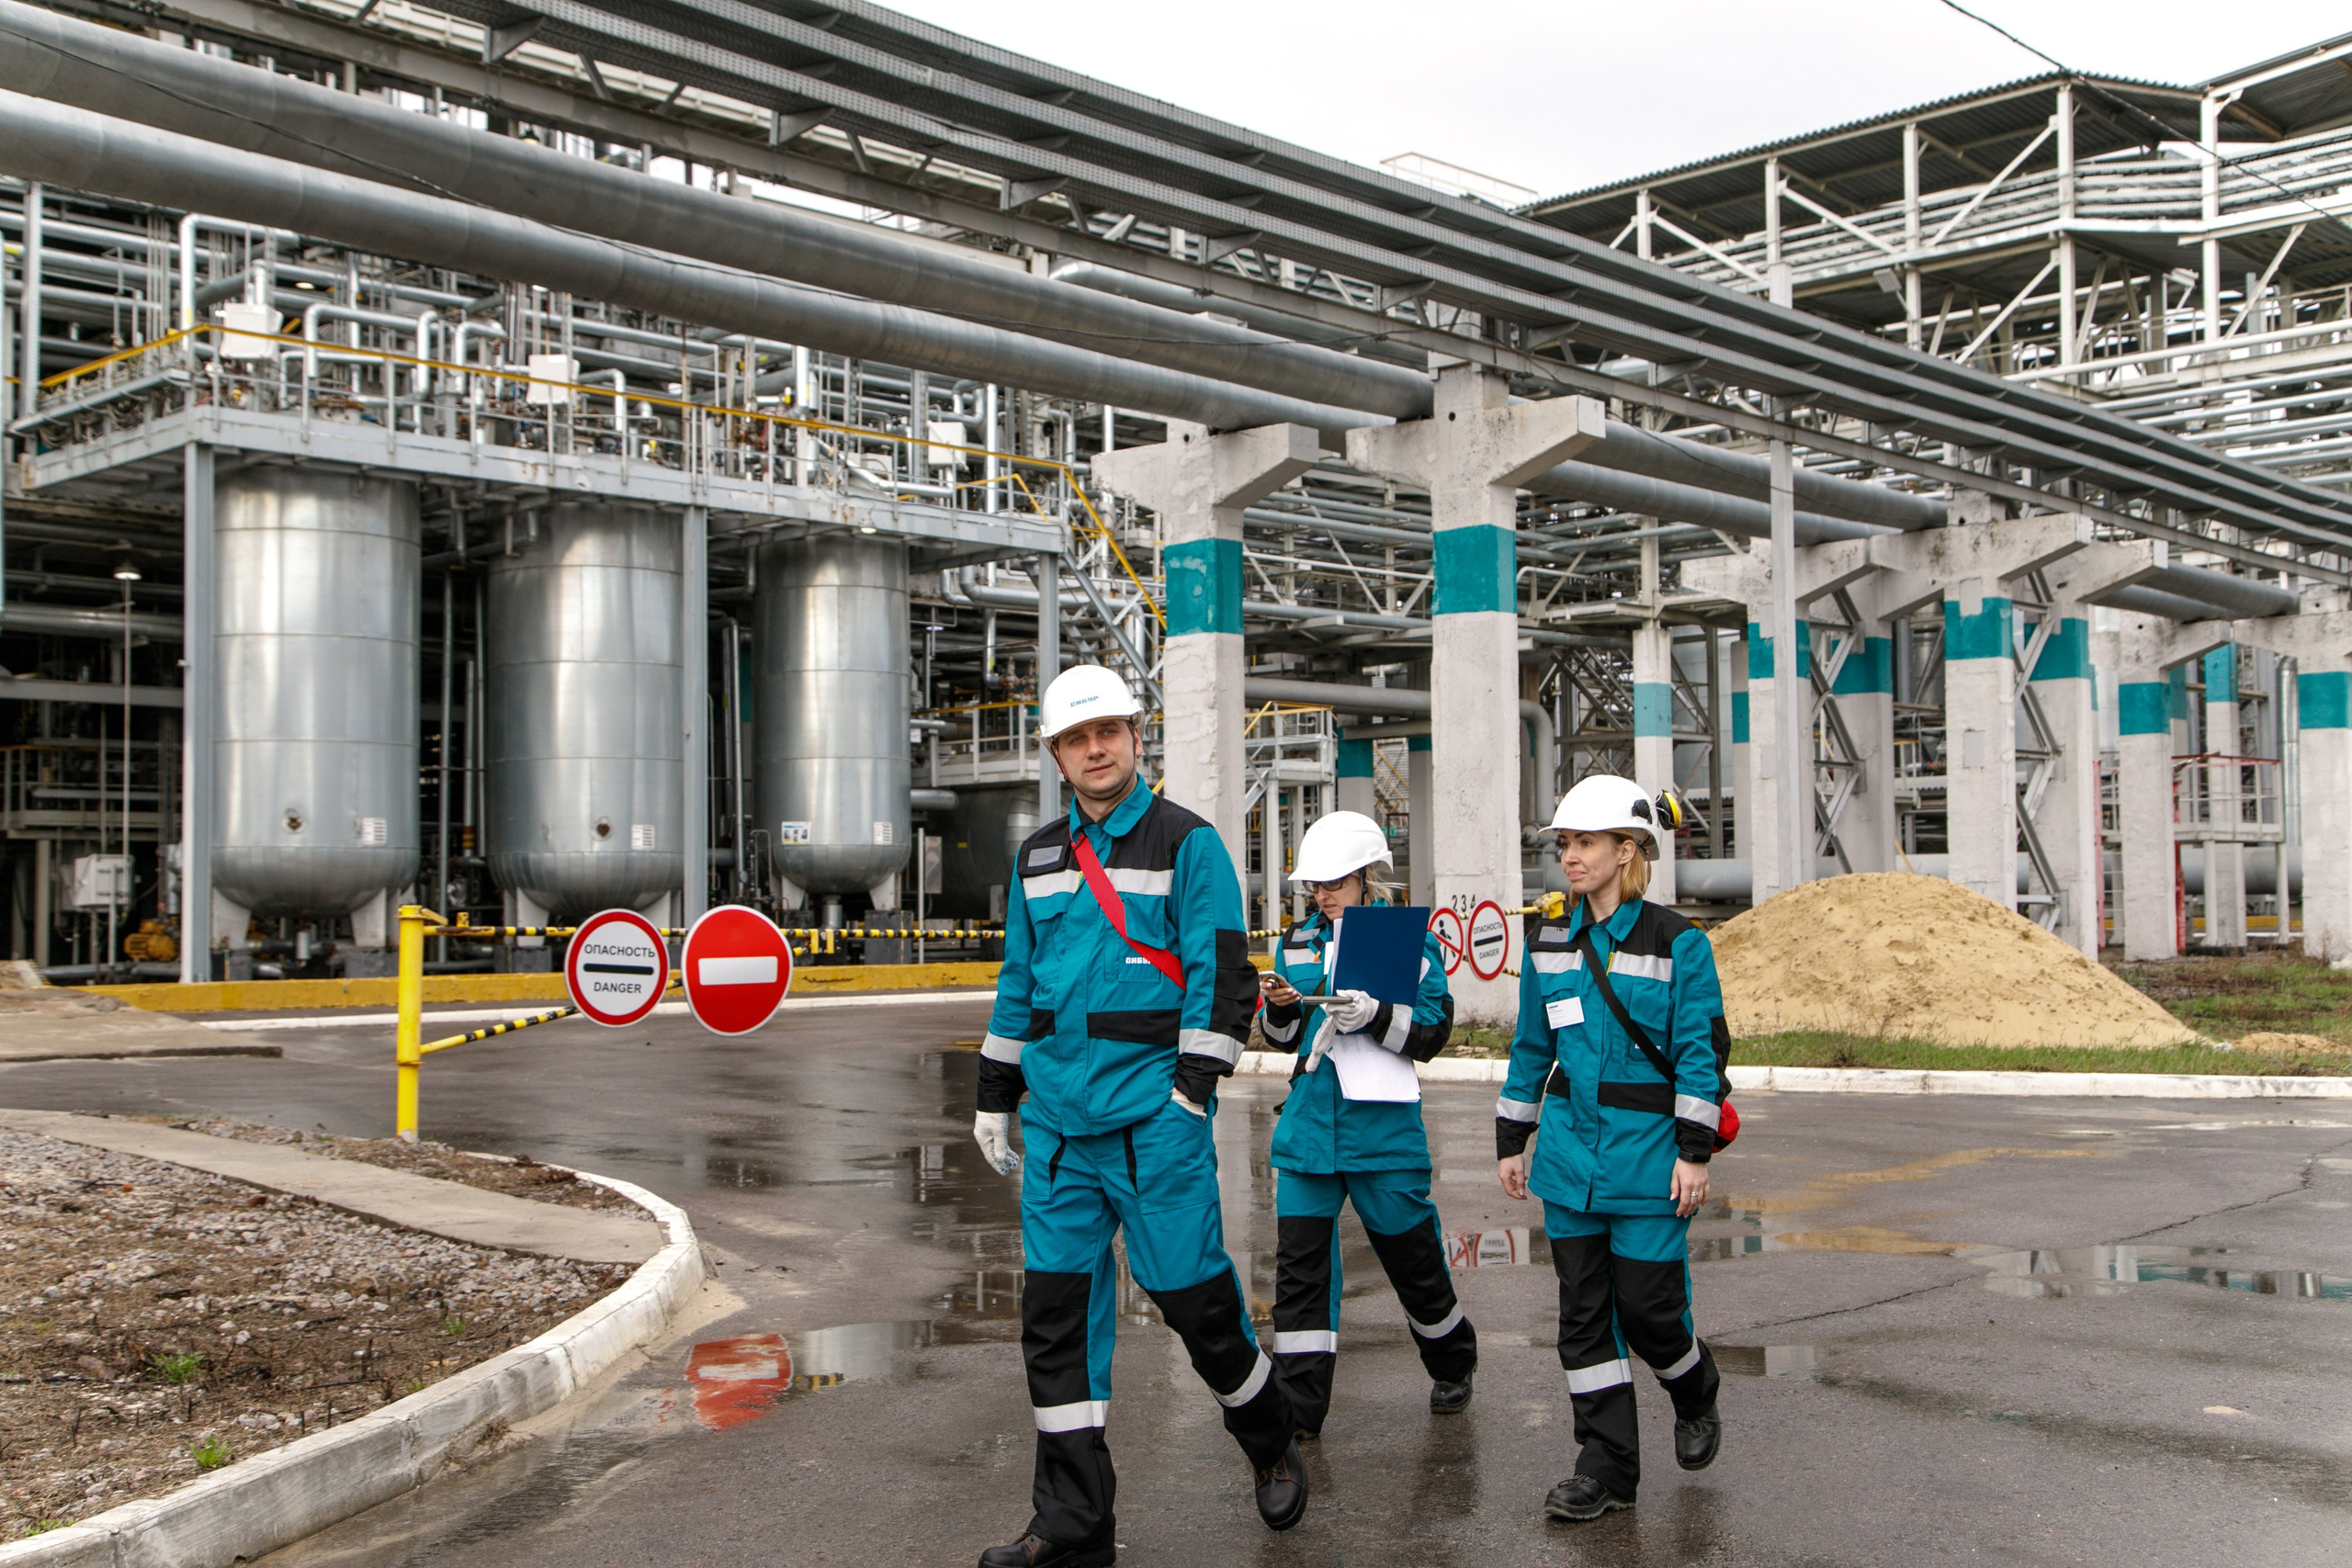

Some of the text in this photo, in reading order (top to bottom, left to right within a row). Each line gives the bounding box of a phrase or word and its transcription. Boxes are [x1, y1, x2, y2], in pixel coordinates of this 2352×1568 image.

[1474, 921, 1503, 934] ОПАСНОСТЬ
[584, 943, 655, 957] ОПАСНОСТЬ
[1479, 948, 1499, 959] DANGER
[594, 982, 641, 993] DANGER
